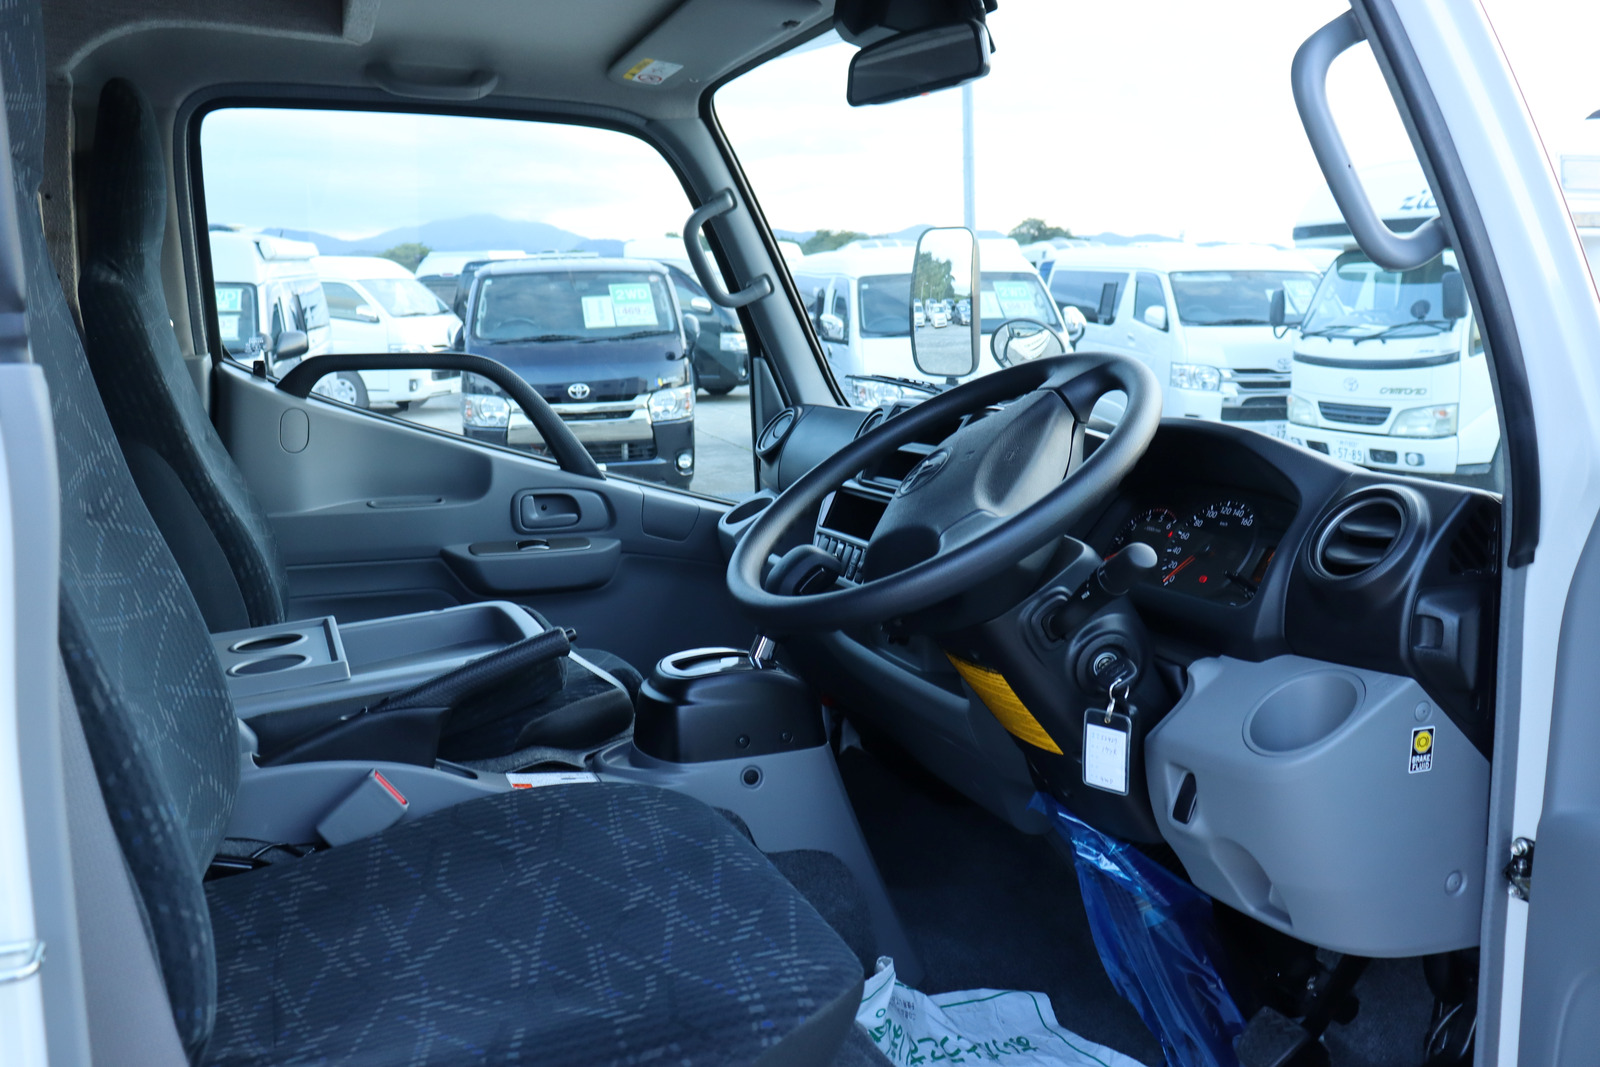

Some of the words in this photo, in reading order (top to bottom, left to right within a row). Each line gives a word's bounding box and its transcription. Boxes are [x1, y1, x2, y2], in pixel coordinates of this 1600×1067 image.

[615, 288, 647, 301] 2WD
[999, 286, 1026, 297] 2WD
[1206, 510, 1218, 518] 100
[1220, 507, 1232, 515] 120
[1233, 509, 1245, 517] 140
[1241, 518, 1253, 527] 160
[1412, 754, 1431, 764] BRAKE
[1411, 762, 1430, 771] FLUID
